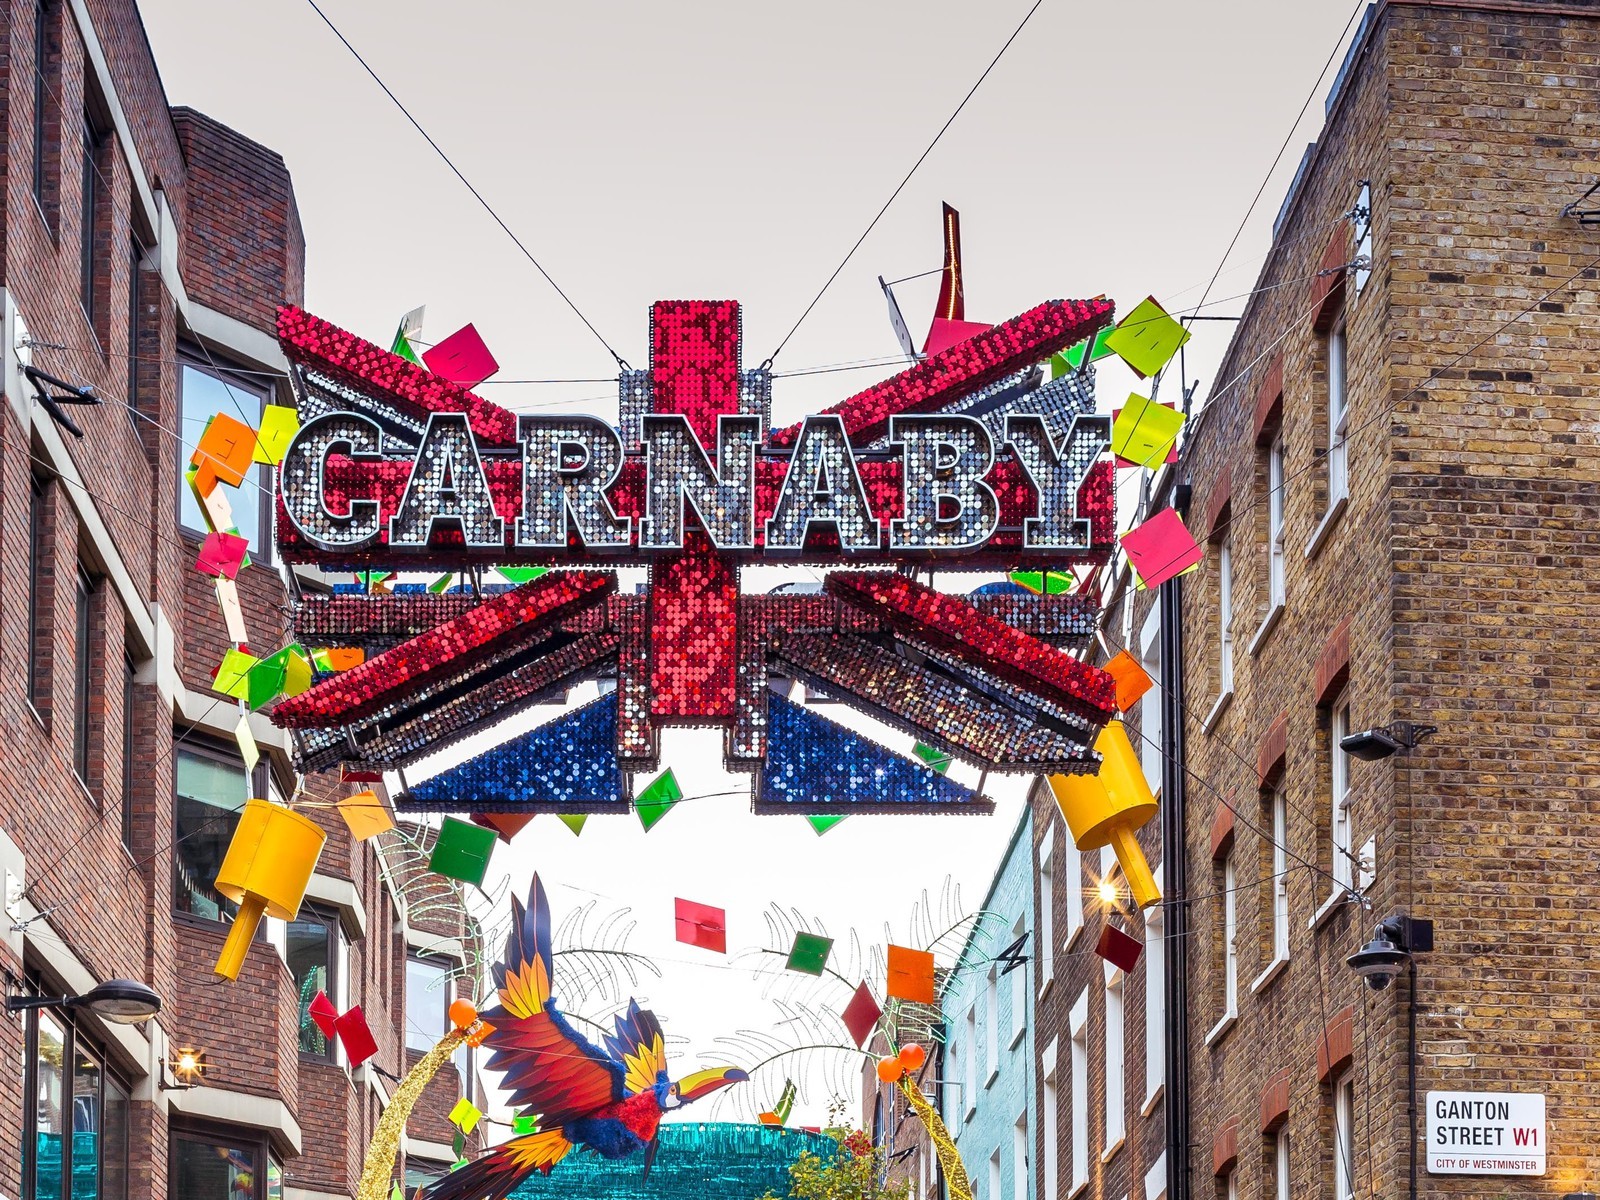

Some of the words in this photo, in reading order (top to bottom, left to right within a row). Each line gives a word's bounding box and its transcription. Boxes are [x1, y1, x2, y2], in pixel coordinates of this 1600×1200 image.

[279, 411, 1114, 552] CARNABY
[1436, 1100, 1509, 1120] GANTON
[1436, 1126, 1504, 1146] STREET
[1513, 1127, 1538, 1147] W1
[1436, 1159, 1456, 1169] CITY
[1458, 1159, 1470, 1169] OF
[1473, 1160, 1537, 1170] WESTMINSTER
